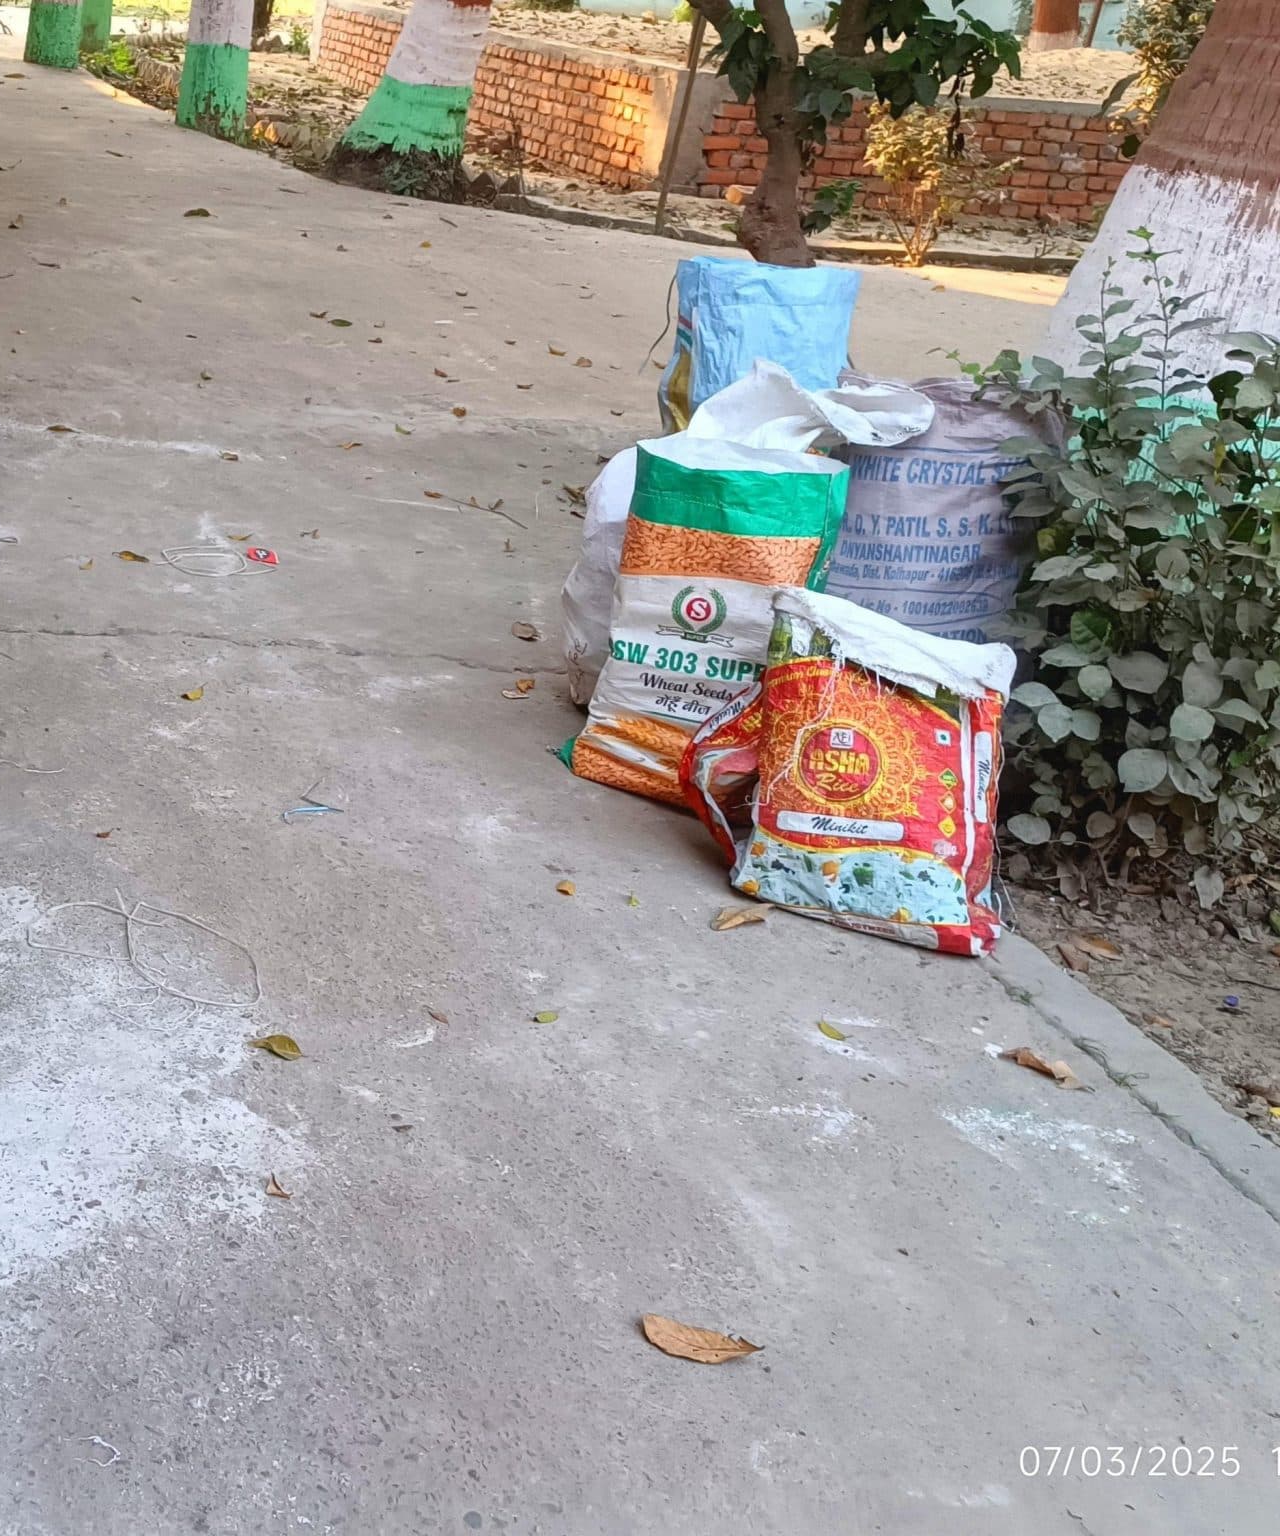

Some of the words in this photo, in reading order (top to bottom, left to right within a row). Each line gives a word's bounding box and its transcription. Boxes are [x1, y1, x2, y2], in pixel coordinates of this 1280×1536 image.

[907, 458, 986, 485] CRYSTAL
[871, 514, 881, 535] Y.
[886, 515, 930, 538] PATIL
[936, 517, 951, 537] S.
[958, 516, 972, 537] S.
[978, 513, 993, 535] K.
[609, 639, 650, 665] SW
[655, 647, 698, 674] 303
[640, 672, 689, 693] Wheat
[692, 683, 733, 702] Seeds
[809, 749, 870, 774] ASHA
[811, 816, 868, 835] Minikit
